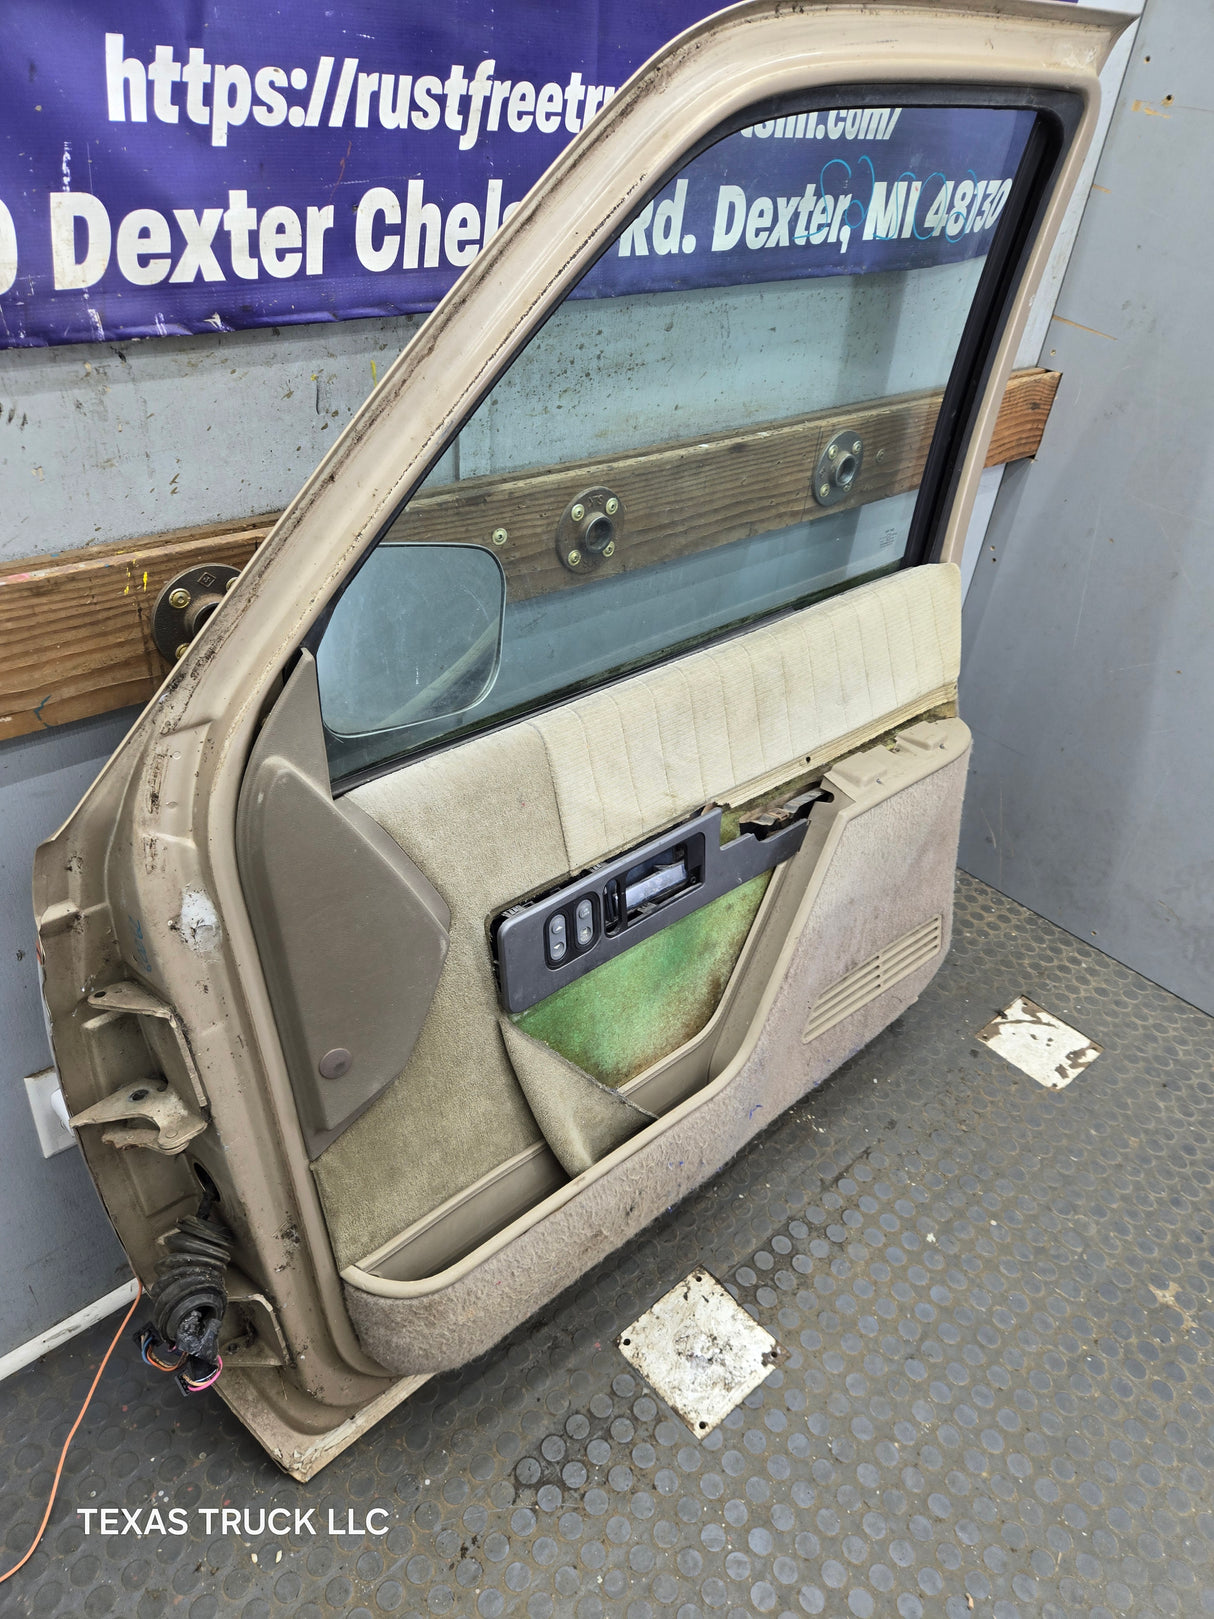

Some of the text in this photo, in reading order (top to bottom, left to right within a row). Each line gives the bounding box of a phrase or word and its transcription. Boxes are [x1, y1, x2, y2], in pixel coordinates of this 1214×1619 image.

[49, 189, 335, 291] Dexter
[711, 182, 853, 254] Dexter,
[862, 179, 922, 242] MI
[923, 177, 1013, 238] 48130
